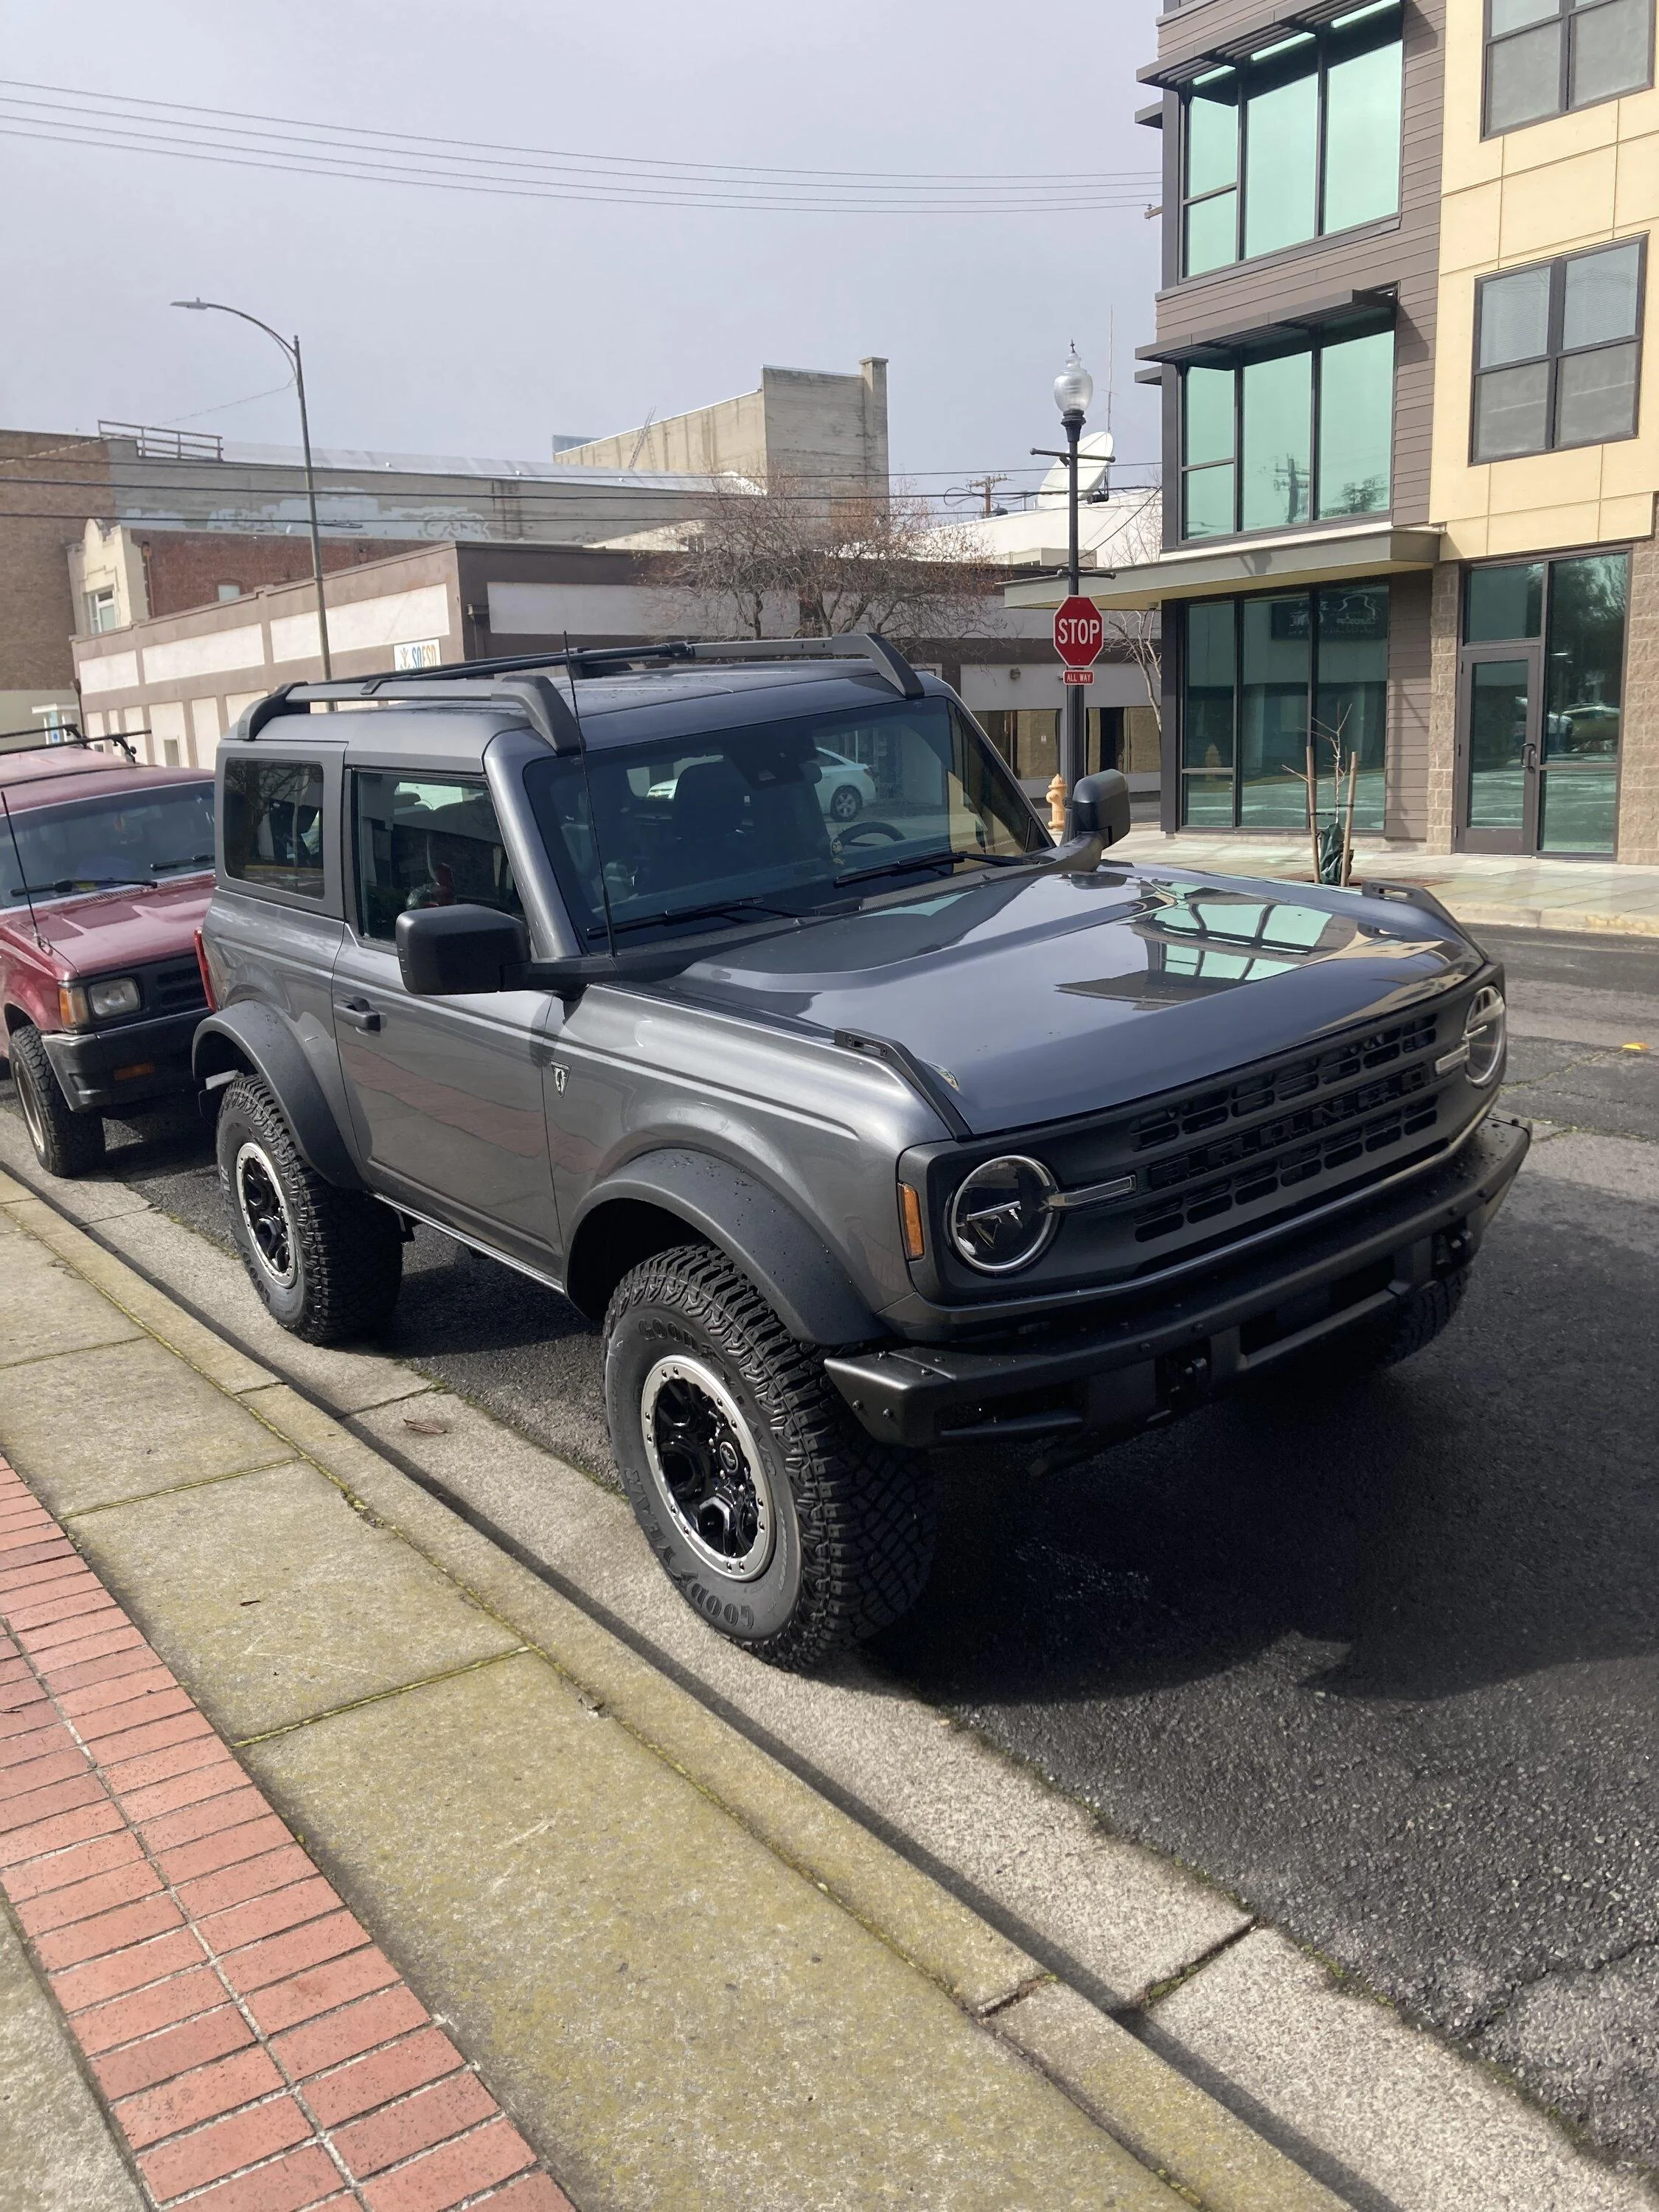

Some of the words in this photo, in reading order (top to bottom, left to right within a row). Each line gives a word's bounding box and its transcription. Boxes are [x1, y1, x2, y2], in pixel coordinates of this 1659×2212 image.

[1057, 618, 1100, 644] STOP
[1067, 673, 1078, 682] ALL
[1079, 673, 1091, 682] WAY
[624, 1467, 755, 1630] GOODYEAR
